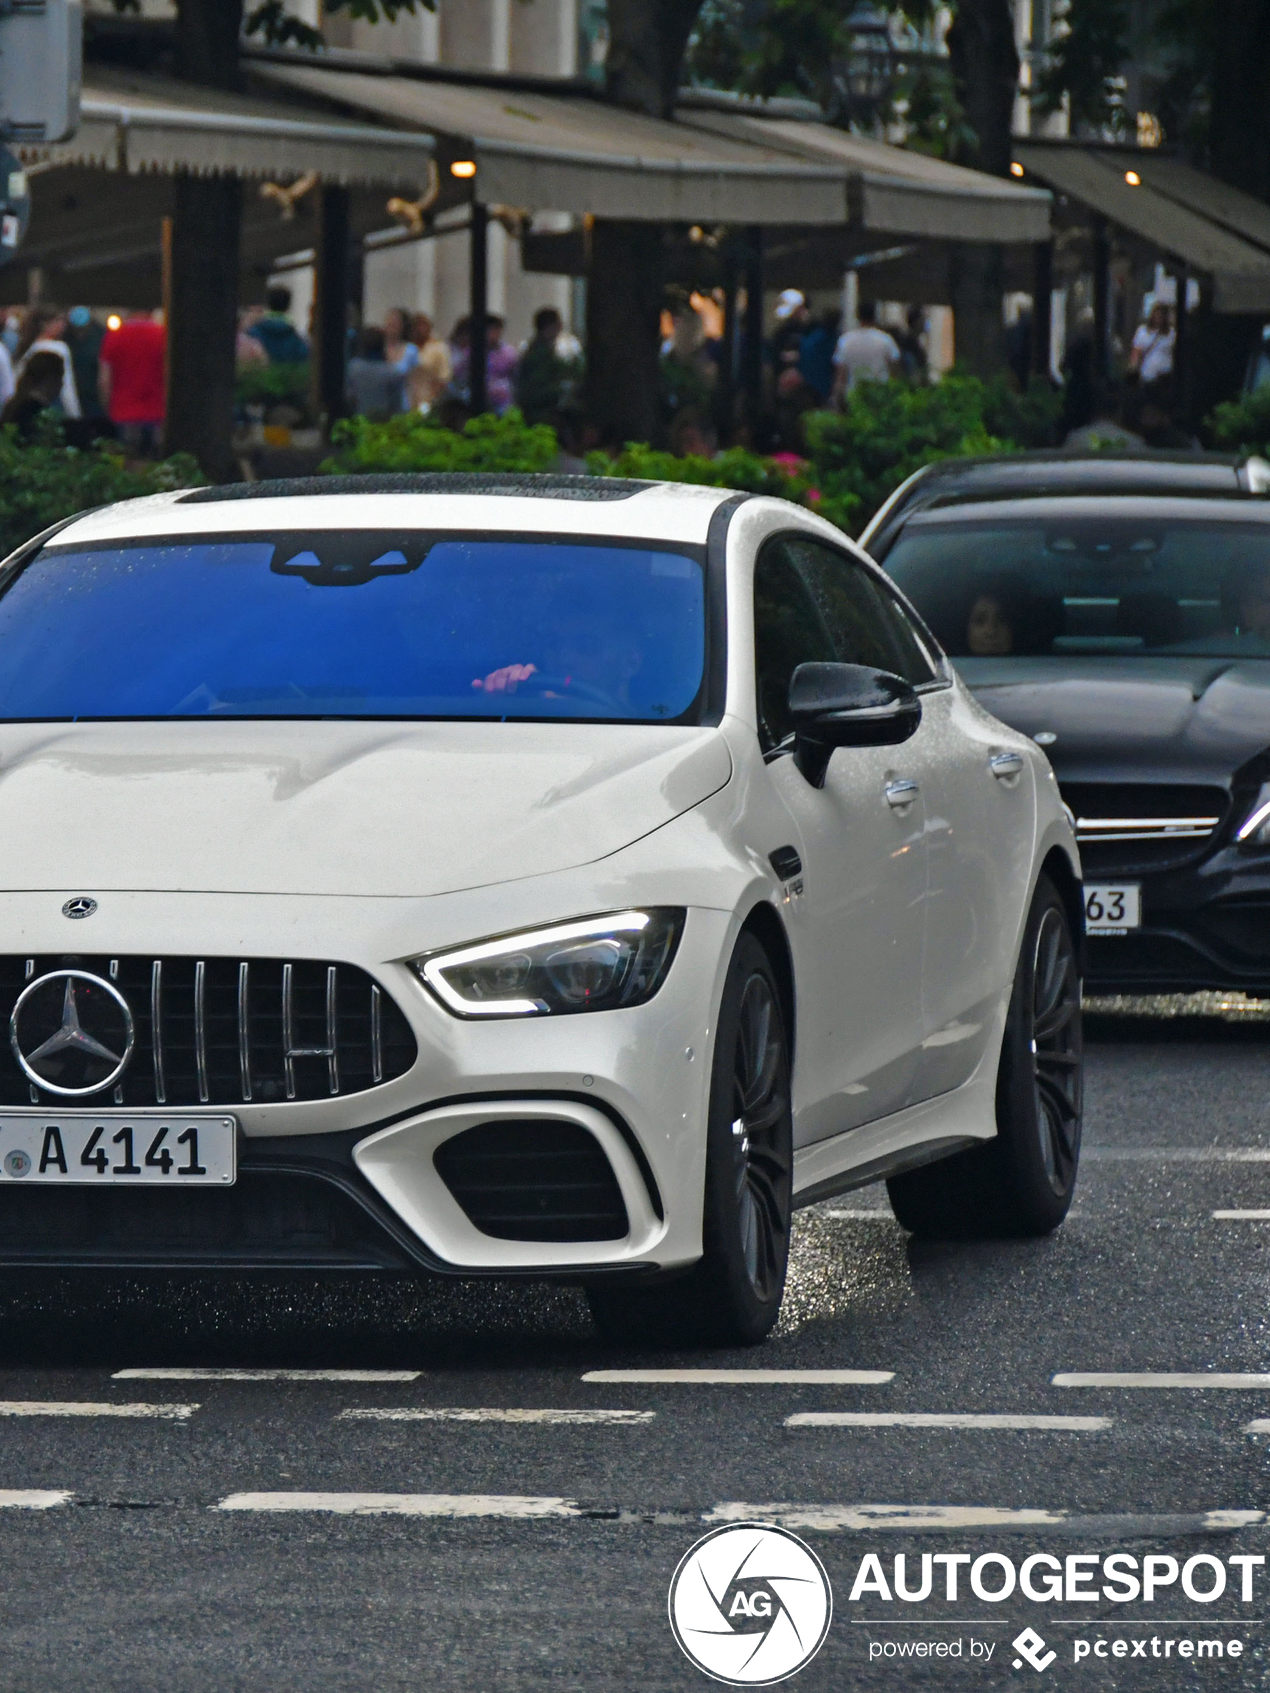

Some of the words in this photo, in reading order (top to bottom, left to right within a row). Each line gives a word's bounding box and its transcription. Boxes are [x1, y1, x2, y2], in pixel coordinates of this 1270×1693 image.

[1086, 891, 1126, 921] 63
[38, 1126, 68, 1173] A
[80, 1126, 207, 1175] 4141
